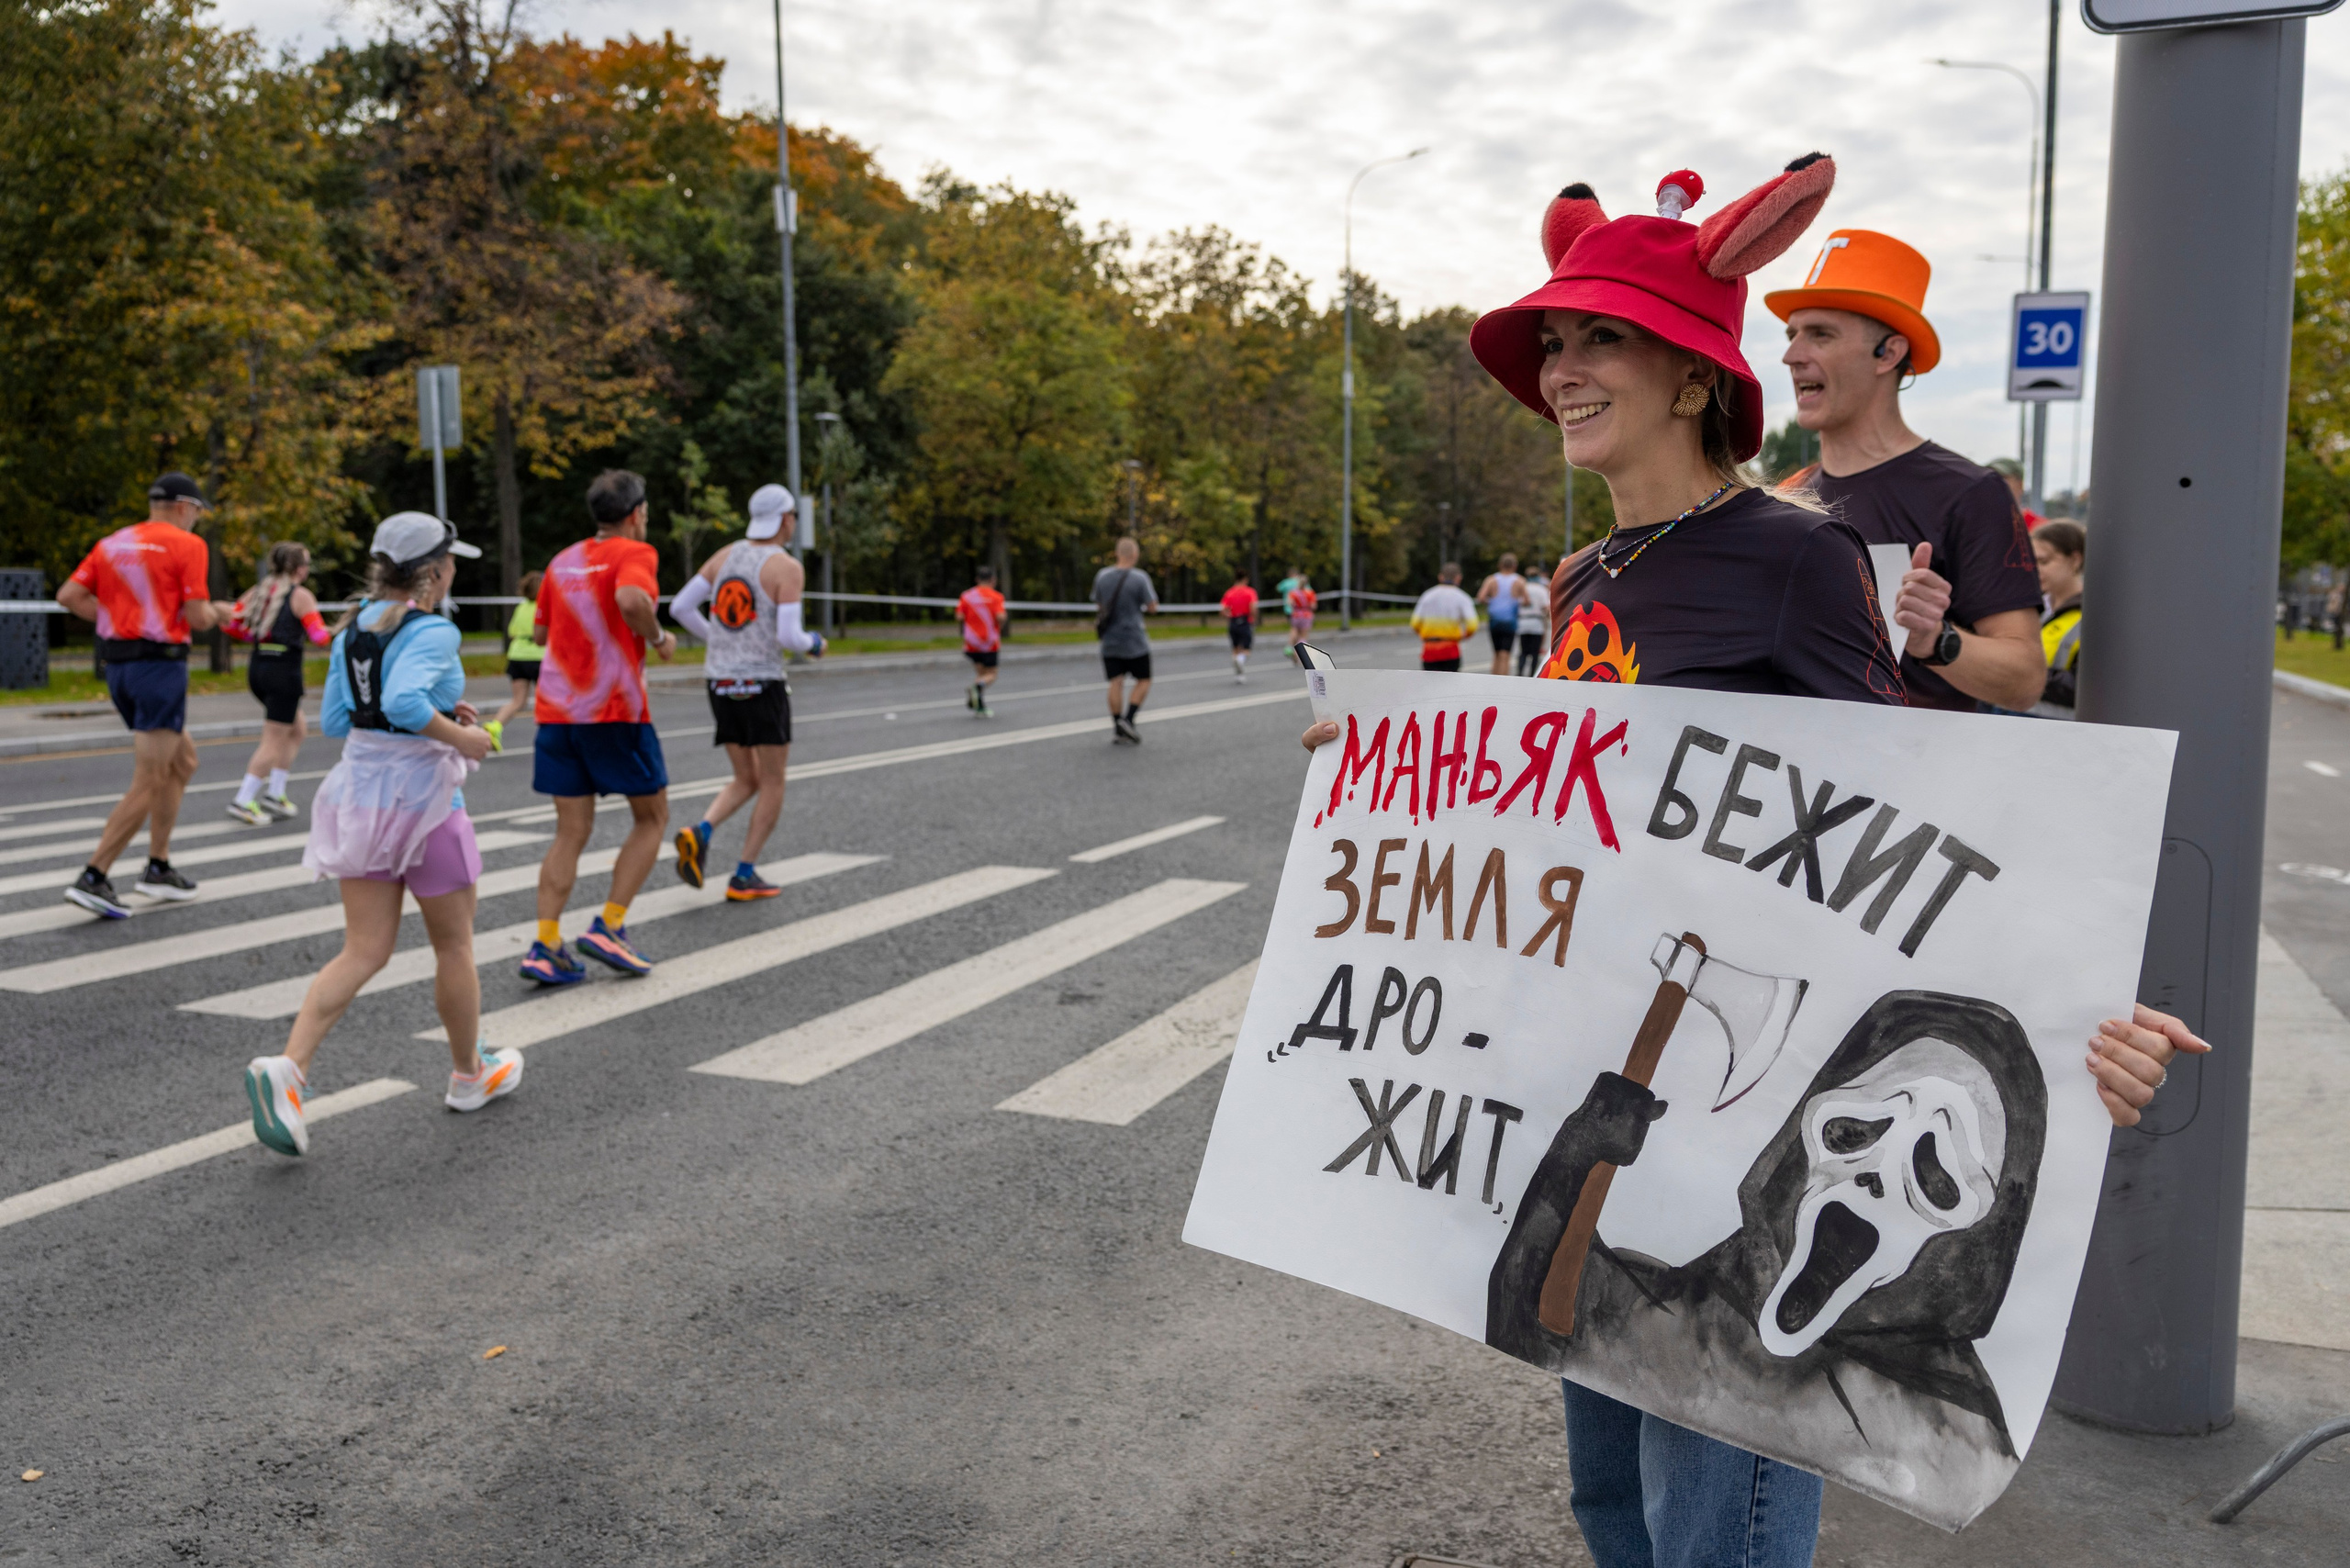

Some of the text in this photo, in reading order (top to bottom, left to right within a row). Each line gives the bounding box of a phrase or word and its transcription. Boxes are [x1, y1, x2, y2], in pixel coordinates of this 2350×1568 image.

[2024, 320, 2074, 355] 30
[1314, 706, 2000, 958] МАНЬЯК БЕЖИТ
[1315, 838, 1583, 967] ЗЕМЛЯ
